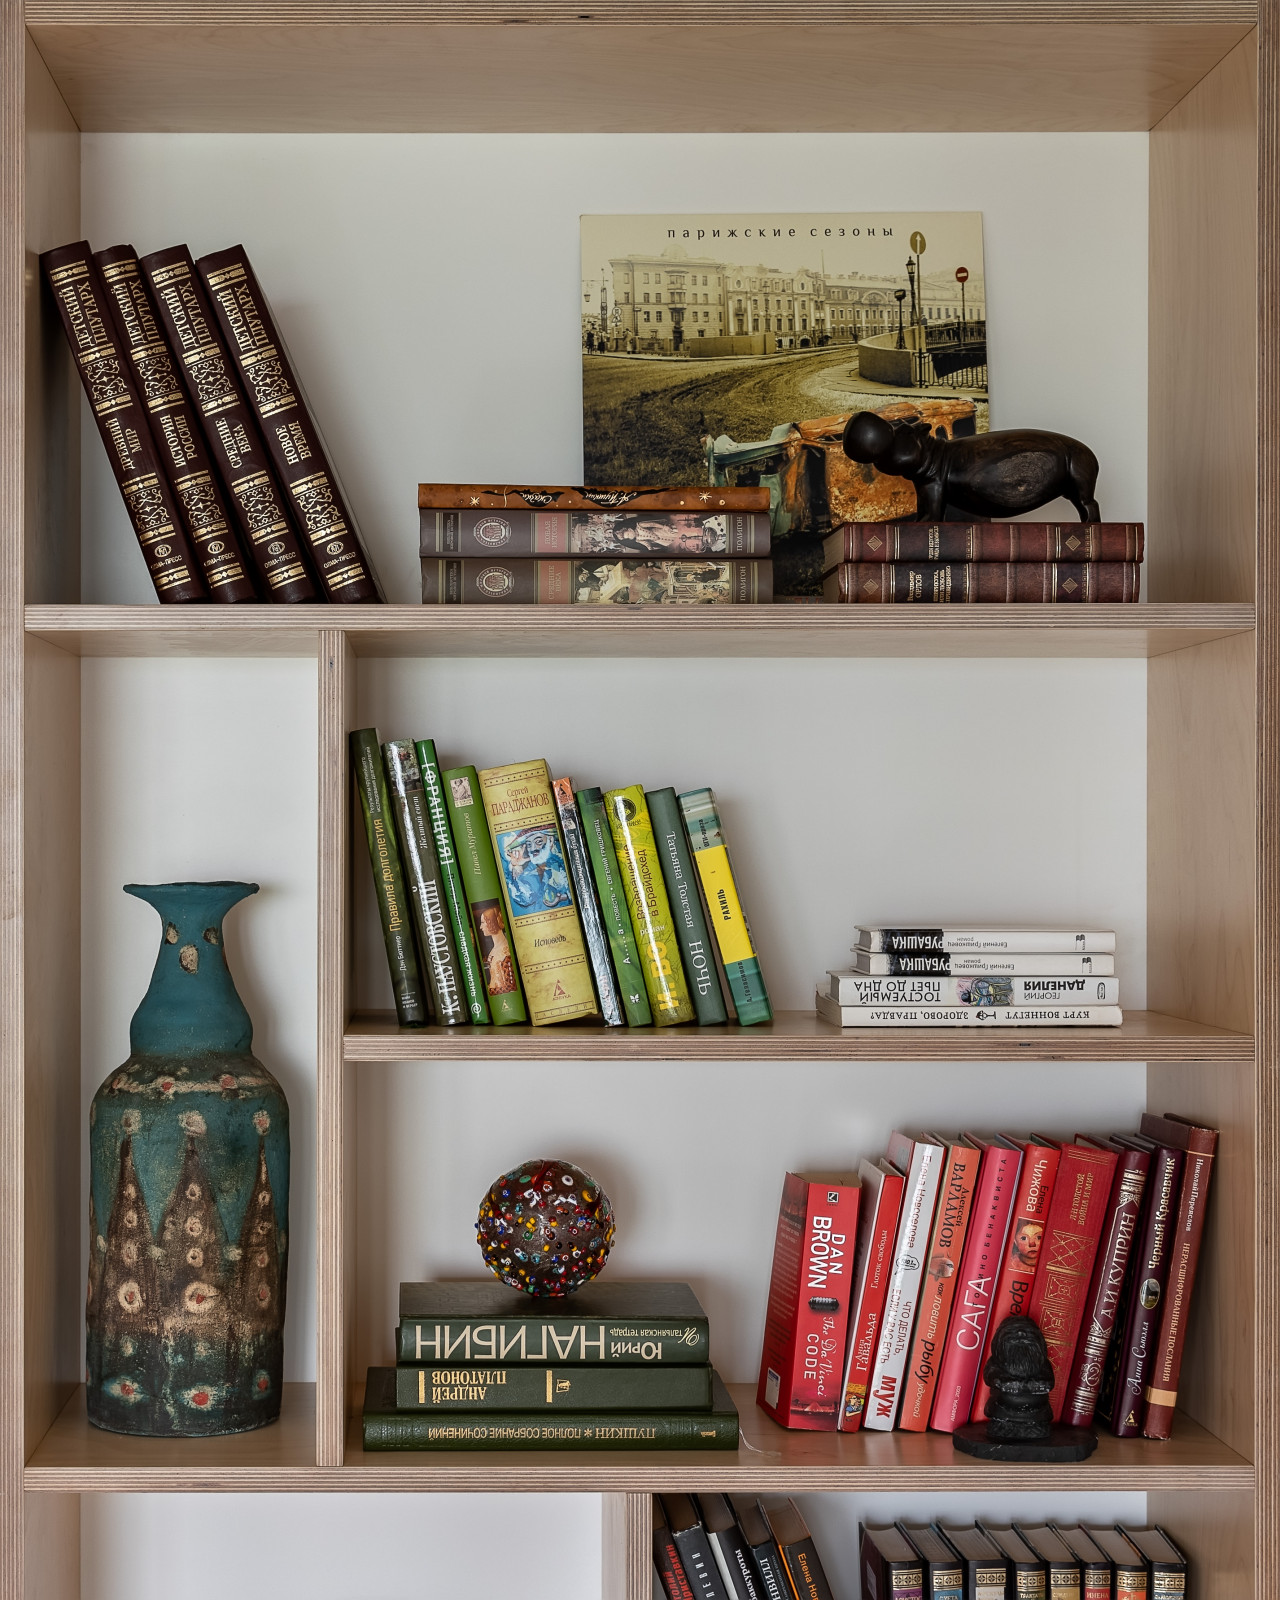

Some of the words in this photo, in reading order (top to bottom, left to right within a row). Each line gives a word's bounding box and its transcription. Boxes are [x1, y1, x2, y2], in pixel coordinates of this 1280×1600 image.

[667, 227, 796, 240] парижские
[810, 227, 894, 237] сезоны
[59, 286, 93, 350] ДЕТСКИЙ
[76, 281, 109, 344] ПЛУТАРХ
[111, 282, 147, 347] ДЕТСКИЙ
[128, 278, 161, 341] ПЛУТАРХ
[162, 286, 197, 351] ДЕТСКИЙ
[179, 281, 212, 345] ПЛУТАРХ
[218, 288, 253, 353] ДЕТСКИЙ
[235, 282, 269, 347] ПЛУТАРХ
[106, 416, 136, 472] ДРЕВНИЙ
[125, 429, 143, 453] МИР
[158, 414, 187, 469] ИСТОРИЯ
[175, 415, 197, 460] РОССИИ
[215, 418, 243, 470] СРЕДНИЕ
[233, 423, 252, 454] ВЕКА
[275, 424, 299, 465] НОВОЕ
[288, 420, 312, 461] ВРЕМЯ
[410, 795, 422, 816] свет
[490, 791, 550, 818] ПАРАДЖАНОВ
[505, 785, 529, 798] Сергей
[413, 816, 429, 849] Желтый
[461, 811, 478, 850] Муратов
[592, 818, 607, 857] ГРИШКОВЕЦ
[370, 817, 395, 883] долголетия
[469, 850, 482, 876] Павел
[635, 848, 658, 908] Брайдсхед
[664, 830, 685, 880] Татьяна
[675, 881, 695, 928] Толстая
[383, 883, 405, 931] Правила
[610, 893, 621, 921] ПОВЕСТЬ
[715, 888, 732, 920] РАХИЛЬ
[410, 878, 456, 994] ПАУСТОВСКИЙ
[532, 932, 567, 949] Исповедь
[892, 935, 943, 949] РУБАШКА
[982, 940, 1007, 948] Евгений
[457, 930, 471, 967] сладкая
[464, 967, 477, 997] жизнь
[644, 939, 672, 978] ВО
[687, 939, 713, 996] НОЧЬ
[899, 957, 950, 970] РУБАШКА
[954, 961, 987, 969] Гришковец
[654, 982, 680, 1010] И.
[853, 979, 881, 991] ДНА
[859, 991, 940, 1004] ТОСТУЕМЫЙ
[884, 979, 906, 991] ДО
[909, 980, 940, 991] ПЬЕТ
[1023, 978, 1085, 990] ДАНЕЛИЯ
[1023, 991, 1060, 1001] ГЕОРГИЙ
[440, 994, 461, 1014] К.
[869, 1010, 917, 1019] ПРАВДА?
[919, 1009, 968, 1019] ЗДОРОВО,
[1005, 1010, 1059, 1019] ВОННЕГУТ
[1062, 1010, 1089, 1019] КУРТ
[1025, 1158, 1047, 1213] Чижова
[1154, 1157, 1176, 1222] Красавчик
[1190, 1158, 1203, 1191] Николай
[938, 1162, 966, 1248] ВАРЛАМОВ
[954, 1187, 970, 1226] Алексей
[981, 1158, 1006, 1248] БЕНАКВИСТА
[1034, 1184, 1049, 1214] Елена
[1077, 1198, 1088, 1225] ВОЙНА
[1084, 1172, 1093, 1190] МИР
[1183, 1191, 1198, 1232] Переяслов
[905, 1187, 925, 1248] Новоселова
[806, 1215, 832, 1289] BROWN
[828, 1233, 845, 1274] DAN
[874, 1229, 887, 1263] свободы
[1106, 1211, 1134, 1285] КУПРИН
[1147, 1223, 1165, 1269] Черный
[870, 1263, 880, 1288] Глоток
[1168, 1241, 1190, 1335] НЕРАСШИФРОВАННЫЕ
[899, 1300, 912, 1319] ЧТО
[925, 1296, 942, 1339] ловить
[954, 1274, 991, 1351] САГА
[1005, 1280, 1029, 1323] Вре
[414, 1324, 605, 1358] НАГИБИН
[609, 1327, 638, 1337] тетрадь
[639, 1326, 699, 1345] Итальянская
[822, 1316, 835, 1336] The
[855, 1312, 876, 1372] Гавальда
[892, 1320, 908, 1356] ДЕЛАТЬ,
[1130, 1320, 1149, 1358] Сьюэлл
[610, 1340, 662, 1359] Юрий
[803, 1333, 819, 1380] CODE
[878, 1340, 892, 1364] ЕСТЬ
[913, 1339, 935, 1384] рыбу
[1161, 1335, 1176, 1382] ПОСЛАНИЯ
[431, 1369, 506, 1384] ПЛАТОНОВ
[431, 1385, 487, 1403] АНДРЕЙ
[1125, 1360, 1144, 1395] Анна
[870, 1374, 898, 1419] муж
[911, 1382, 925, 1418] удочкой
[427, 1427, 487, 1440] СОЧИНЕНИЙ
[488, 1427, 539, 1438] СОБРАНИЕ
[541, 1427, 581, 1438] ПОЛНОЕ
[594, 1427, 655, 1438] ПУШКИН
[796, 1552, 813, 1583] Елена
